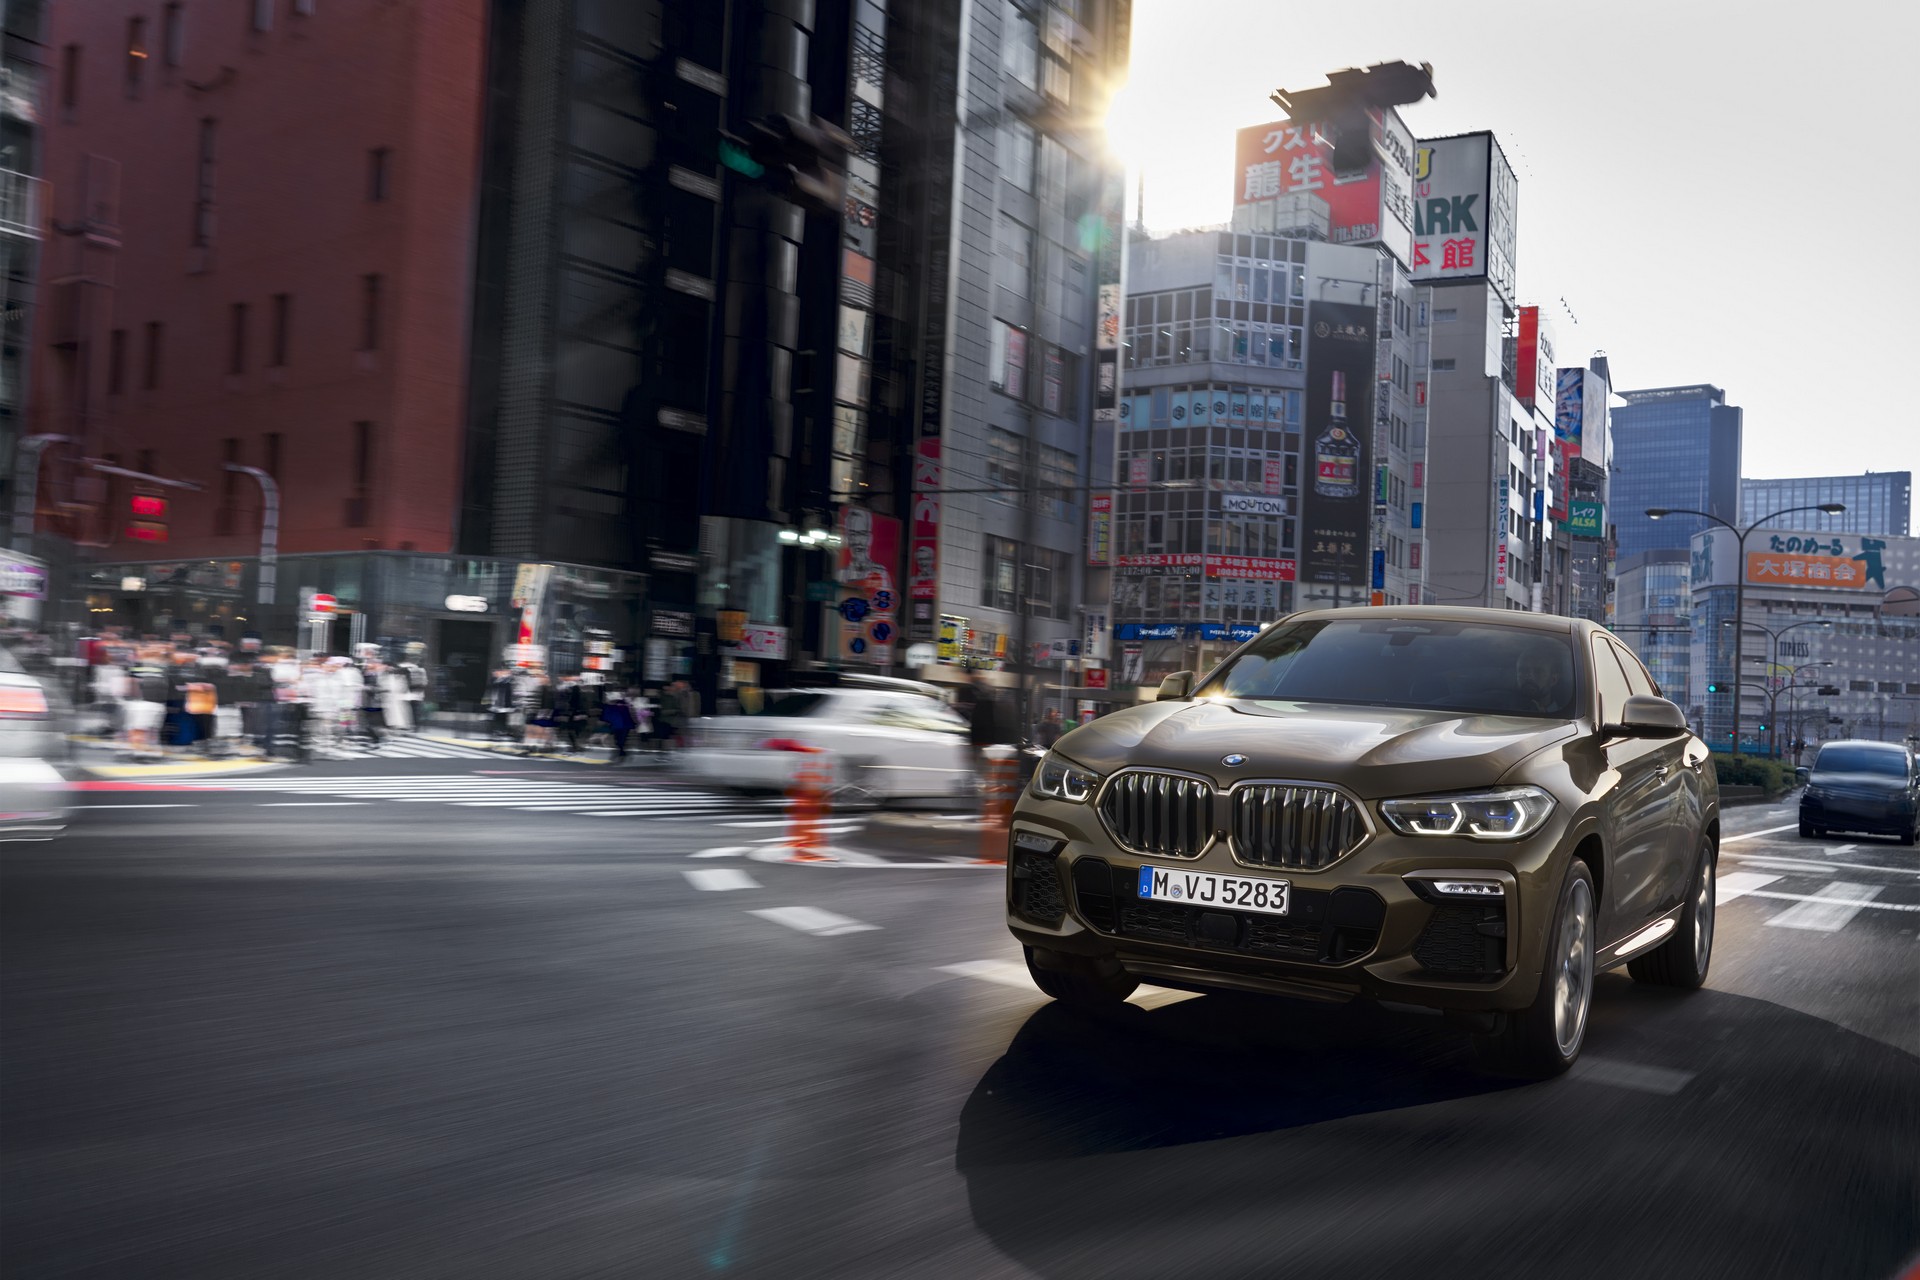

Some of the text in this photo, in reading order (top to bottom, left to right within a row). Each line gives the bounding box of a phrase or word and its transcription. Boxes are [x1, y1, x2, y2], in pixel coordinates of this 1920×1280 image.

[1263, 121, 1330, 154] クスリ
[1244, 154, 1368, 200] 龍生
[1228, 498, 1281, 513] MOUTON
[1572, 506, 1596, 517] レイク
[1571, 517, 1596, 527] ALSA
[1770, 534, 1843, 556] たのめーる
[1757, 559, 1856, 581] 大塚商会
[1143, 885, 1149, 893] D
[1153, 871, 1285, 909] M VJ 5283
